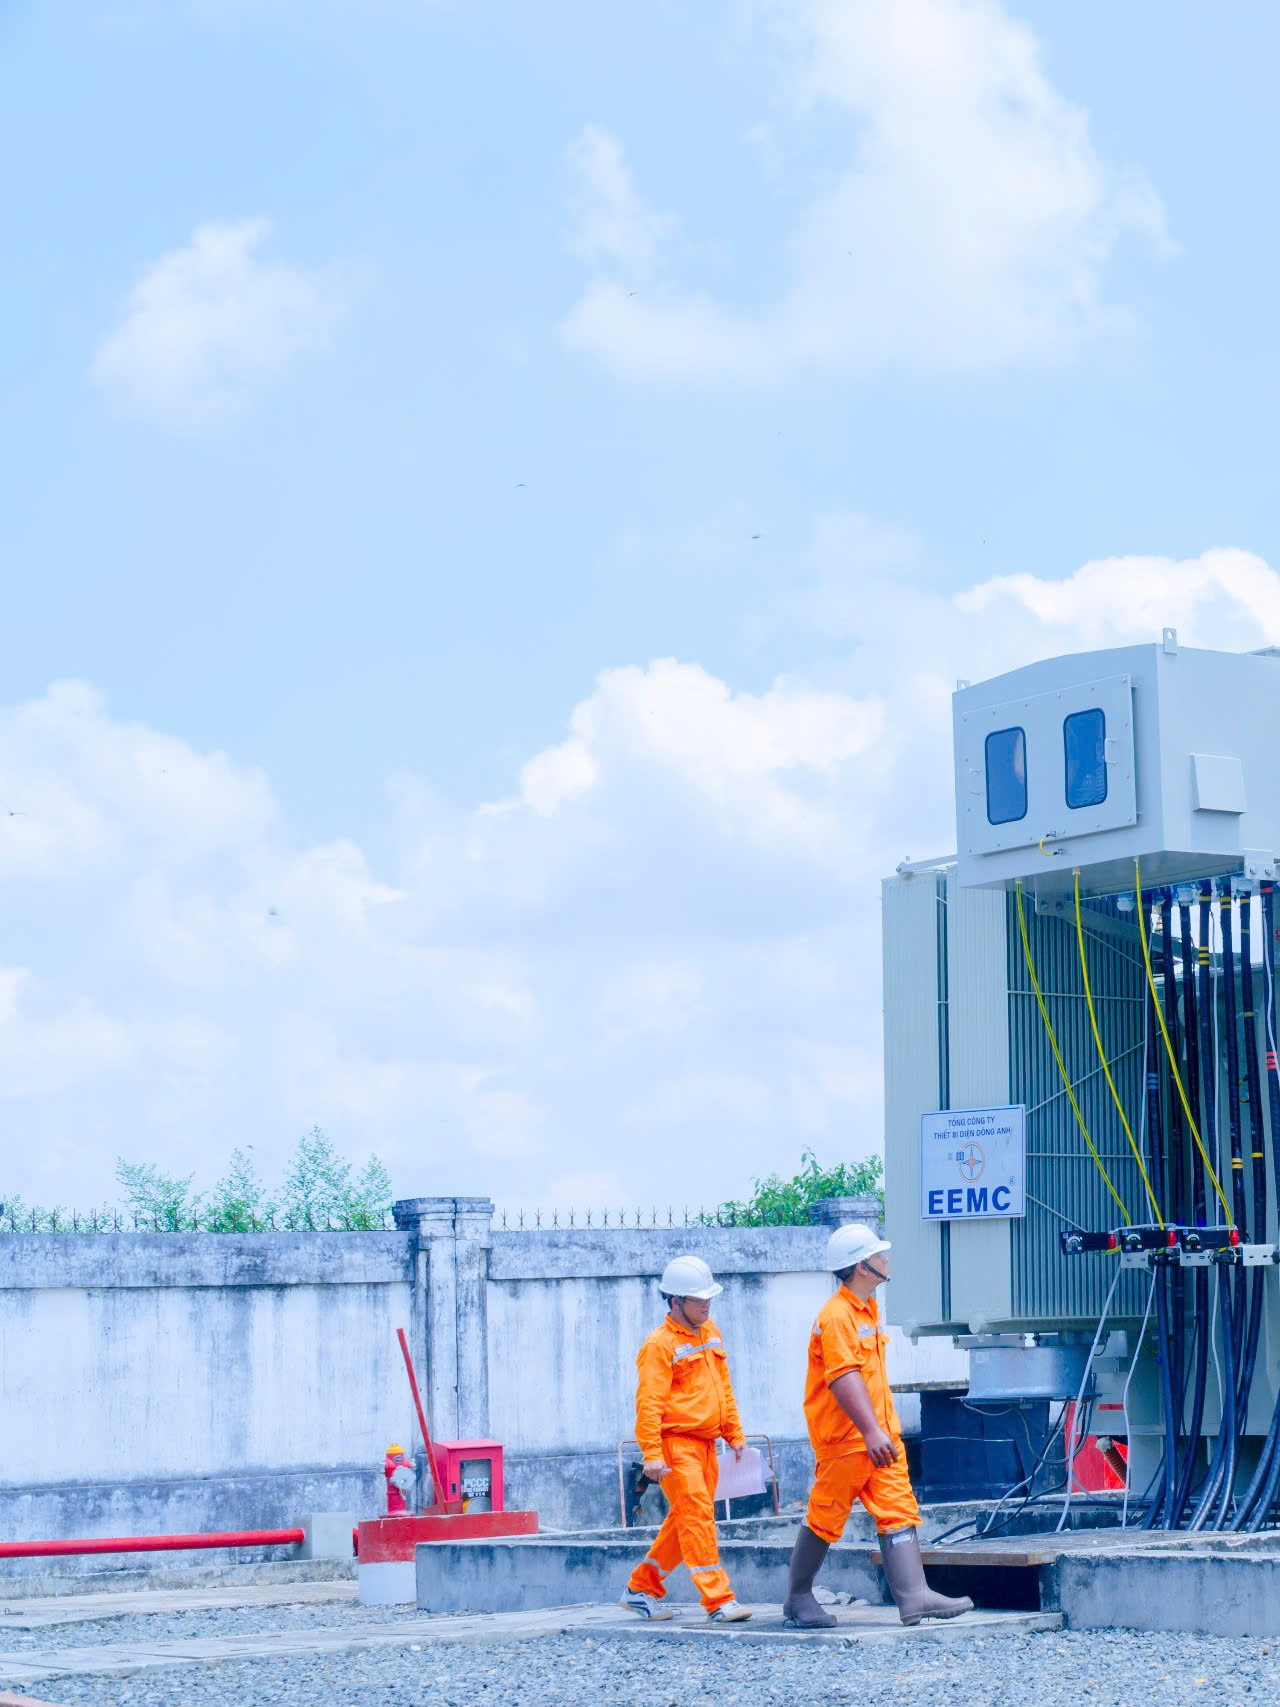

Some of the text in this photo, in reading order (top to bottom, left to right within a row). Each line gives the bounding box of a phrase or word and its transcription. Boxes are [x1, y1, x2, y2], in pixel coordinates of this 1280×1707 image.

[986, 1116, 995, 1124] TY
[996, 1126, 1011, 1135] ANH
[928, 1185, 1011, 1215] EEMC
[464, 1477, 489, 1488] PCCC
